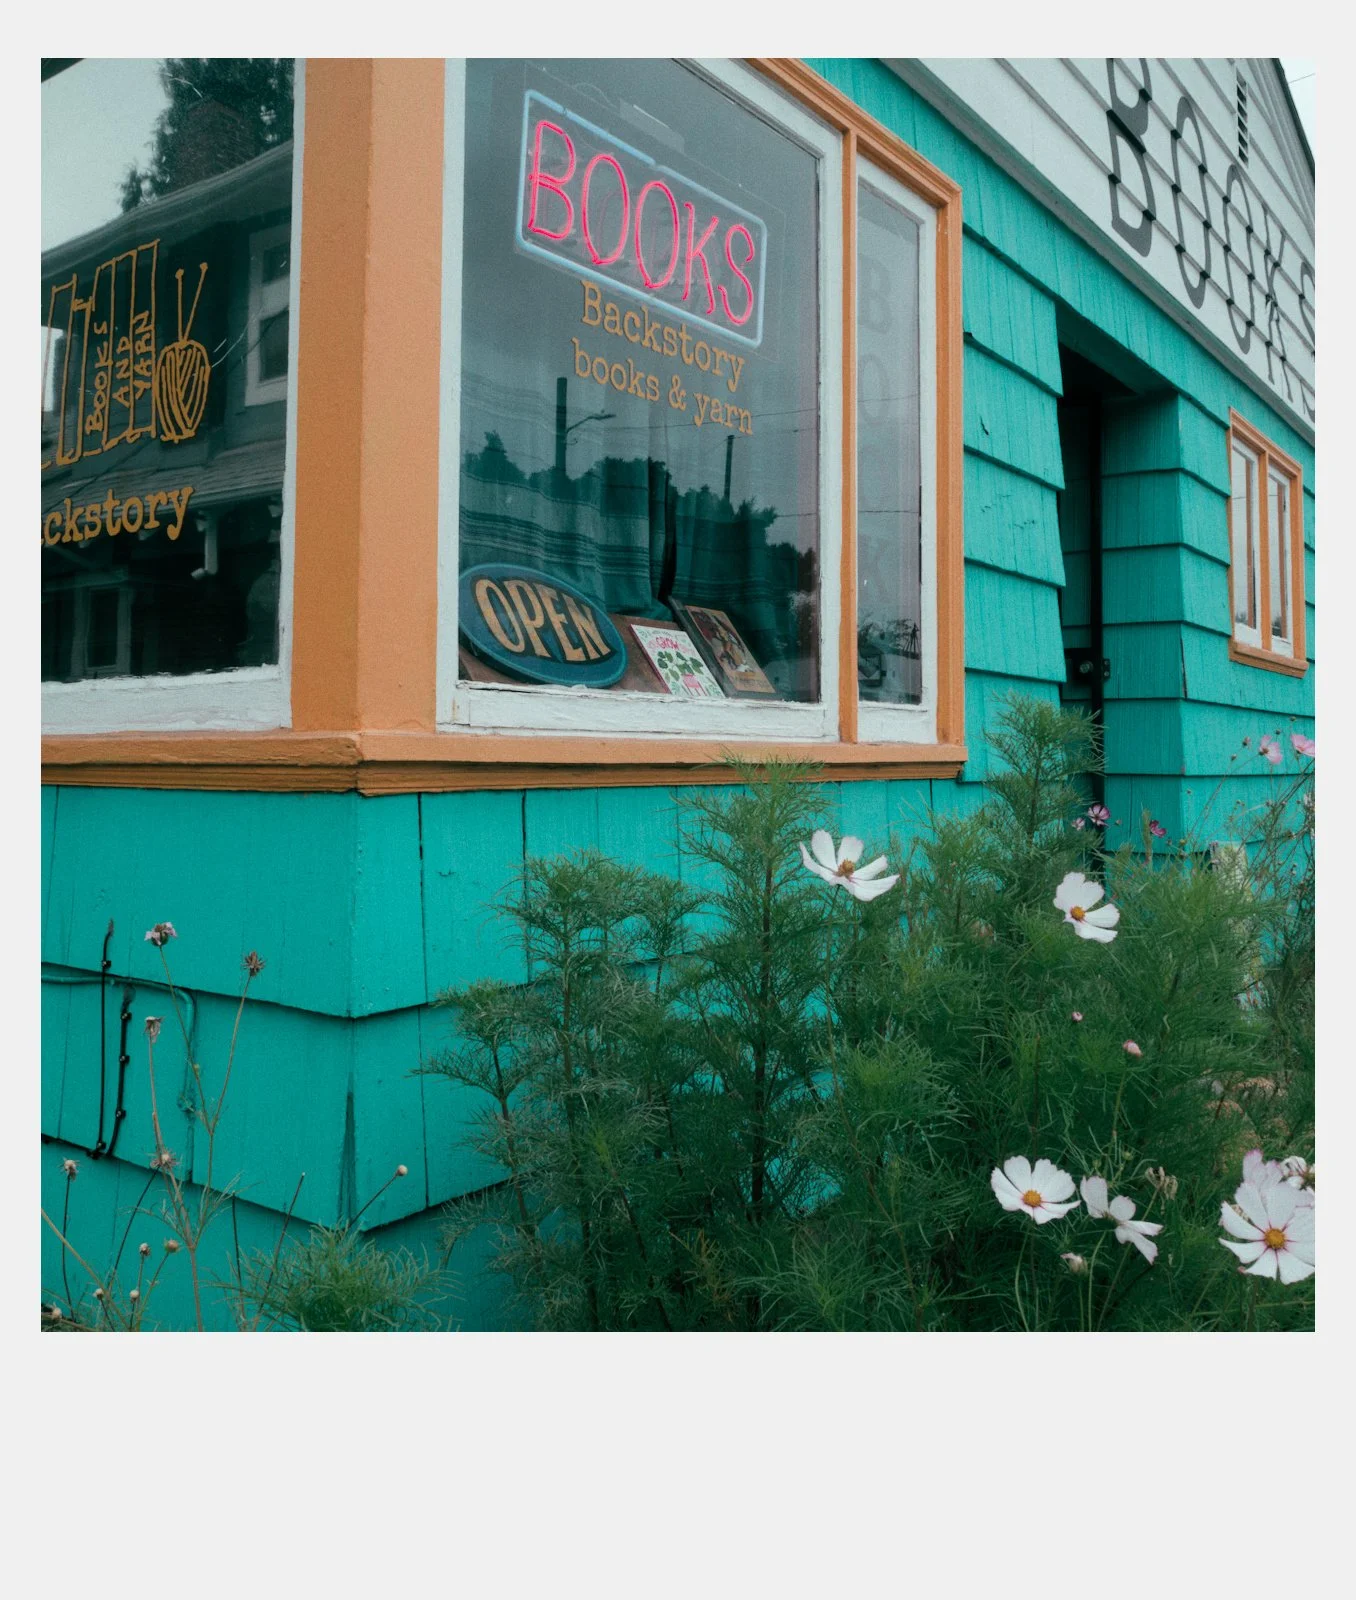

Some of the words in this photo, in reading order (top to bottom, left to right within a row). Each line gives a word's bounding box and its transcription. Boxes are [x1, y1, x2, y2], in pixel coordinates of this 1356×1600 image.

[527, 120, 755, 325] BOOKS
[85, 321, 112, 435] BOOKS
[112, 336, 131, 408] AND
[133, 310, 152, 399] YARN
[580, 279, 745, 392] Backstory
[571, 337, 661, 402] books
[668, 374, 687, 411] &
[693, 391, 754, 435] yarn
[41, 486, 195, 545] ckstory
[474, 578, 612, 662] OPEN
